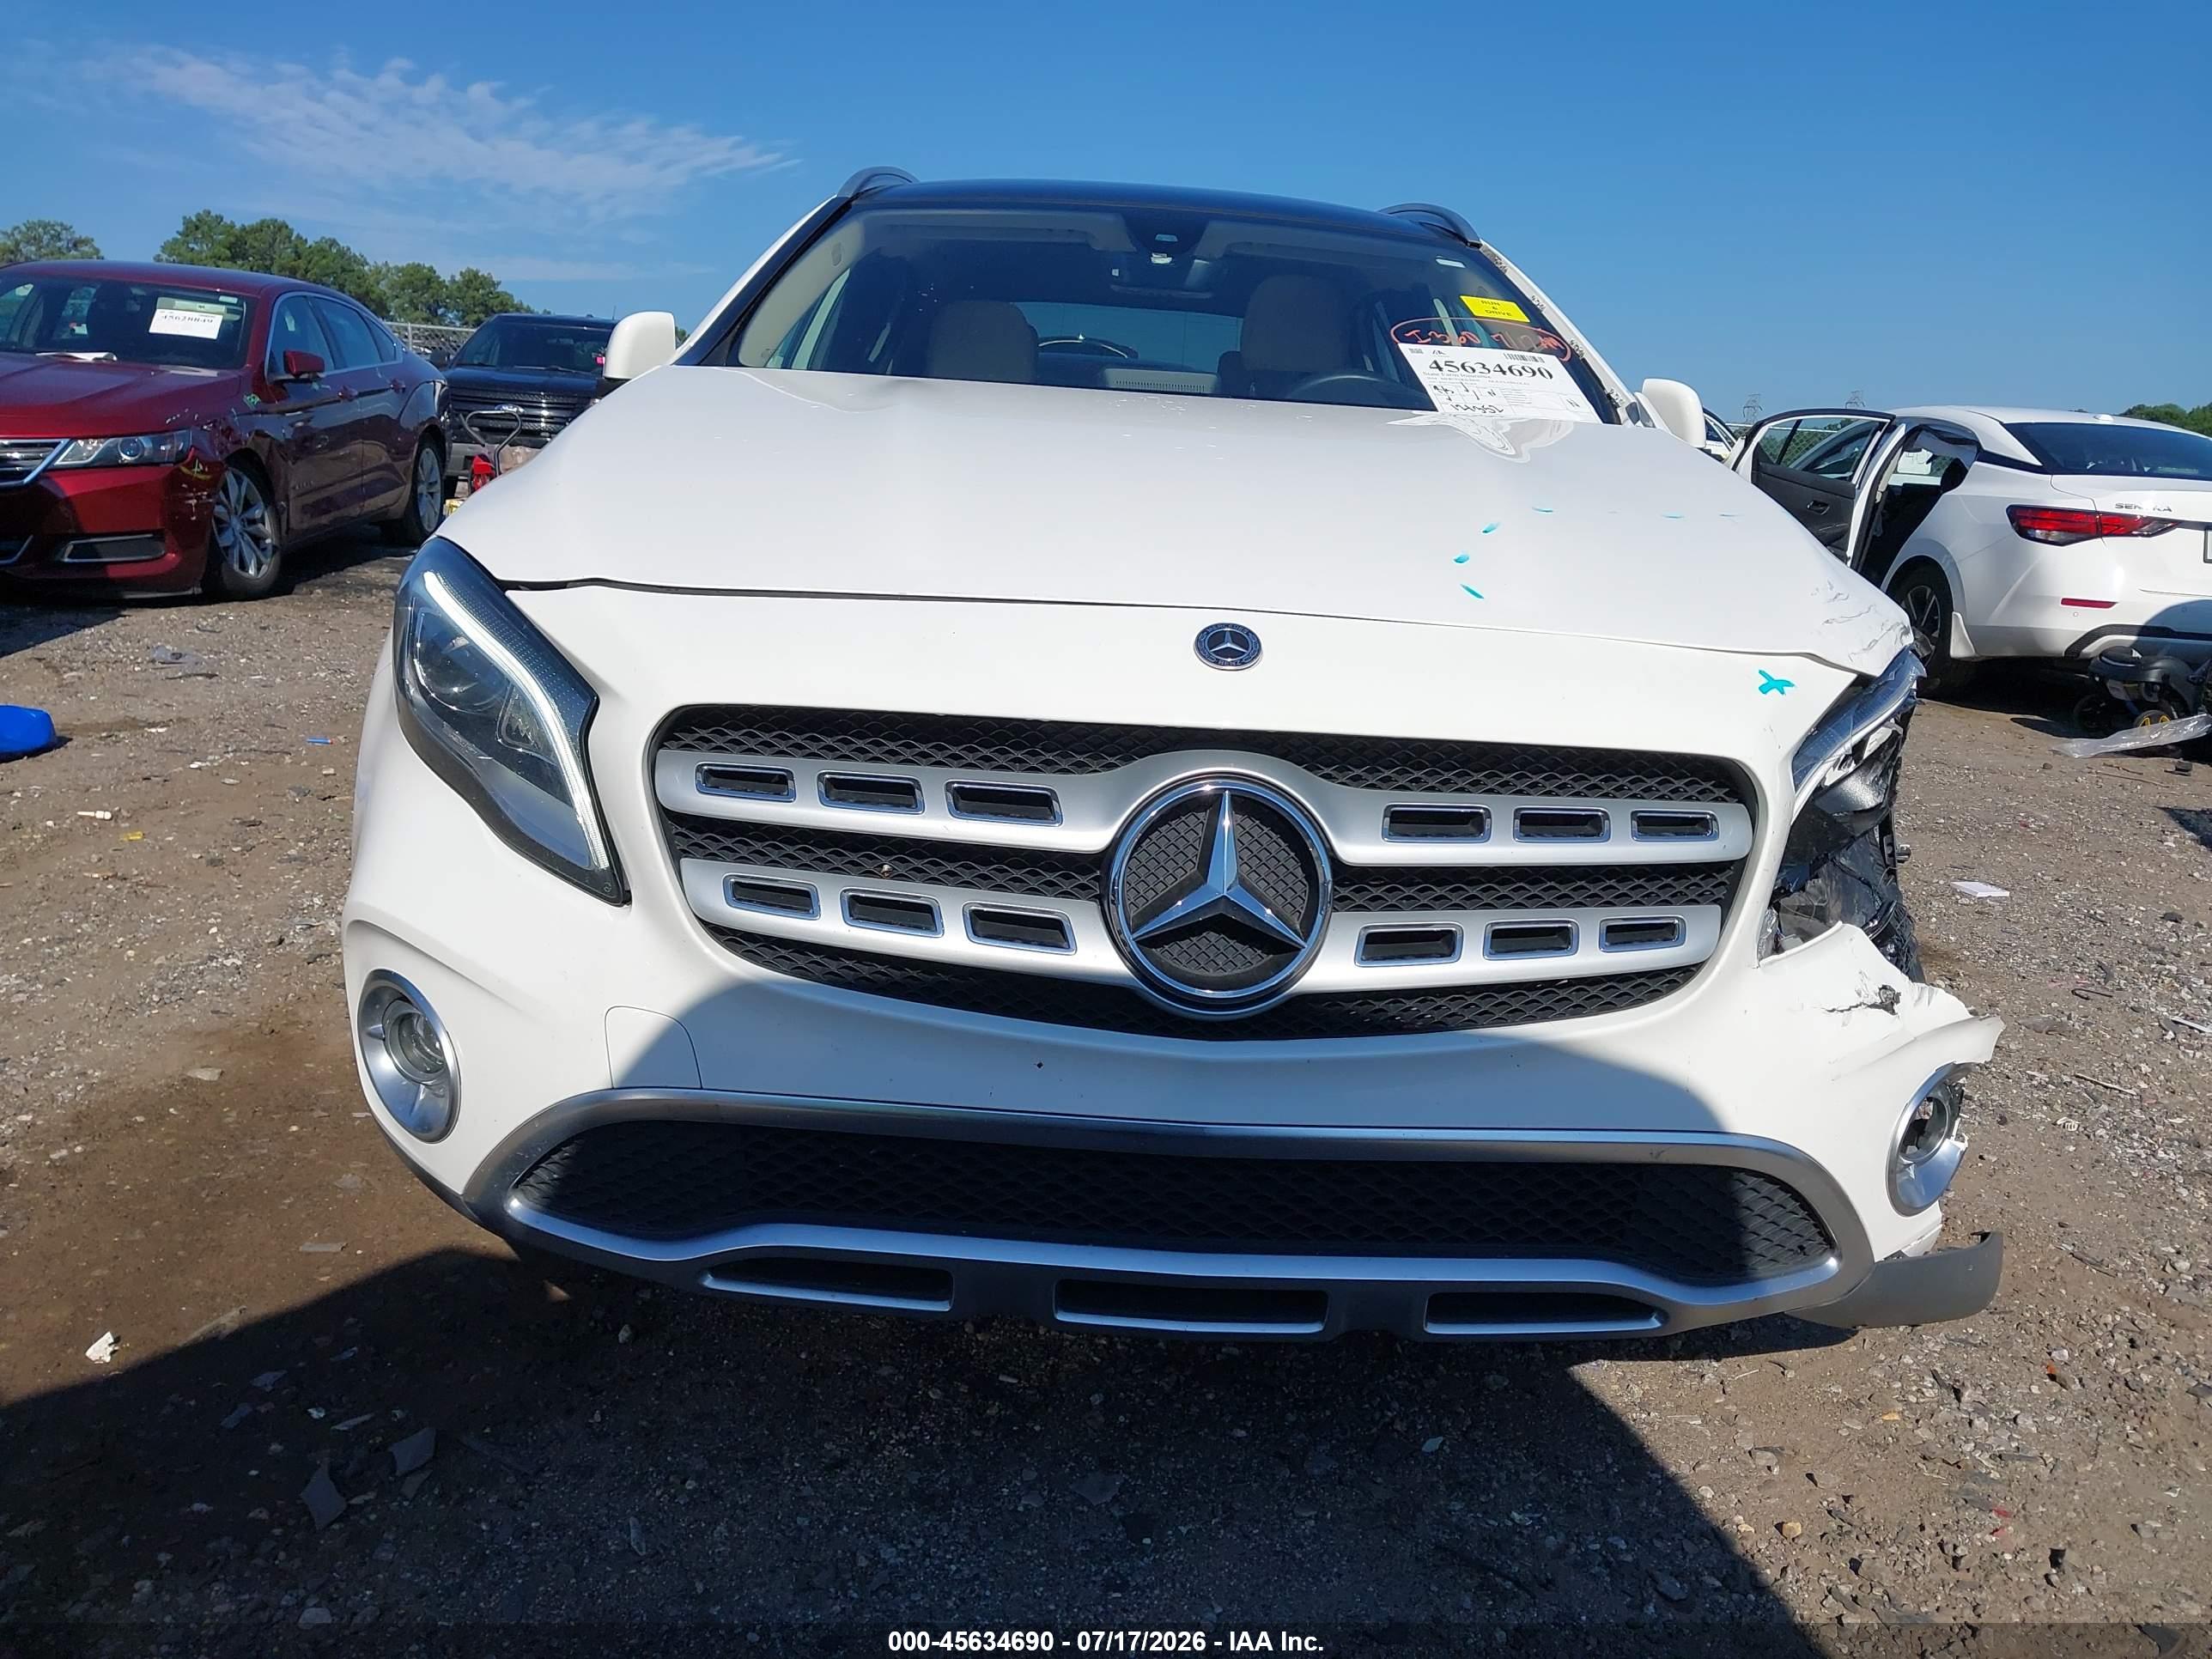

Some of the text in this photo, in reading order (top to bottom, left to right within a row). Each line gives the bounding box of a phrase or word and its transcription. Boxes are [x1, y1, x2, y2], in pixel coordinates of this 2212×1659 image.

[1429, 360, 1553, 380] 45634690
[2115, 502, 2172, 513] SENRA
[1206, 623, 1249, 634] MERCEDES
